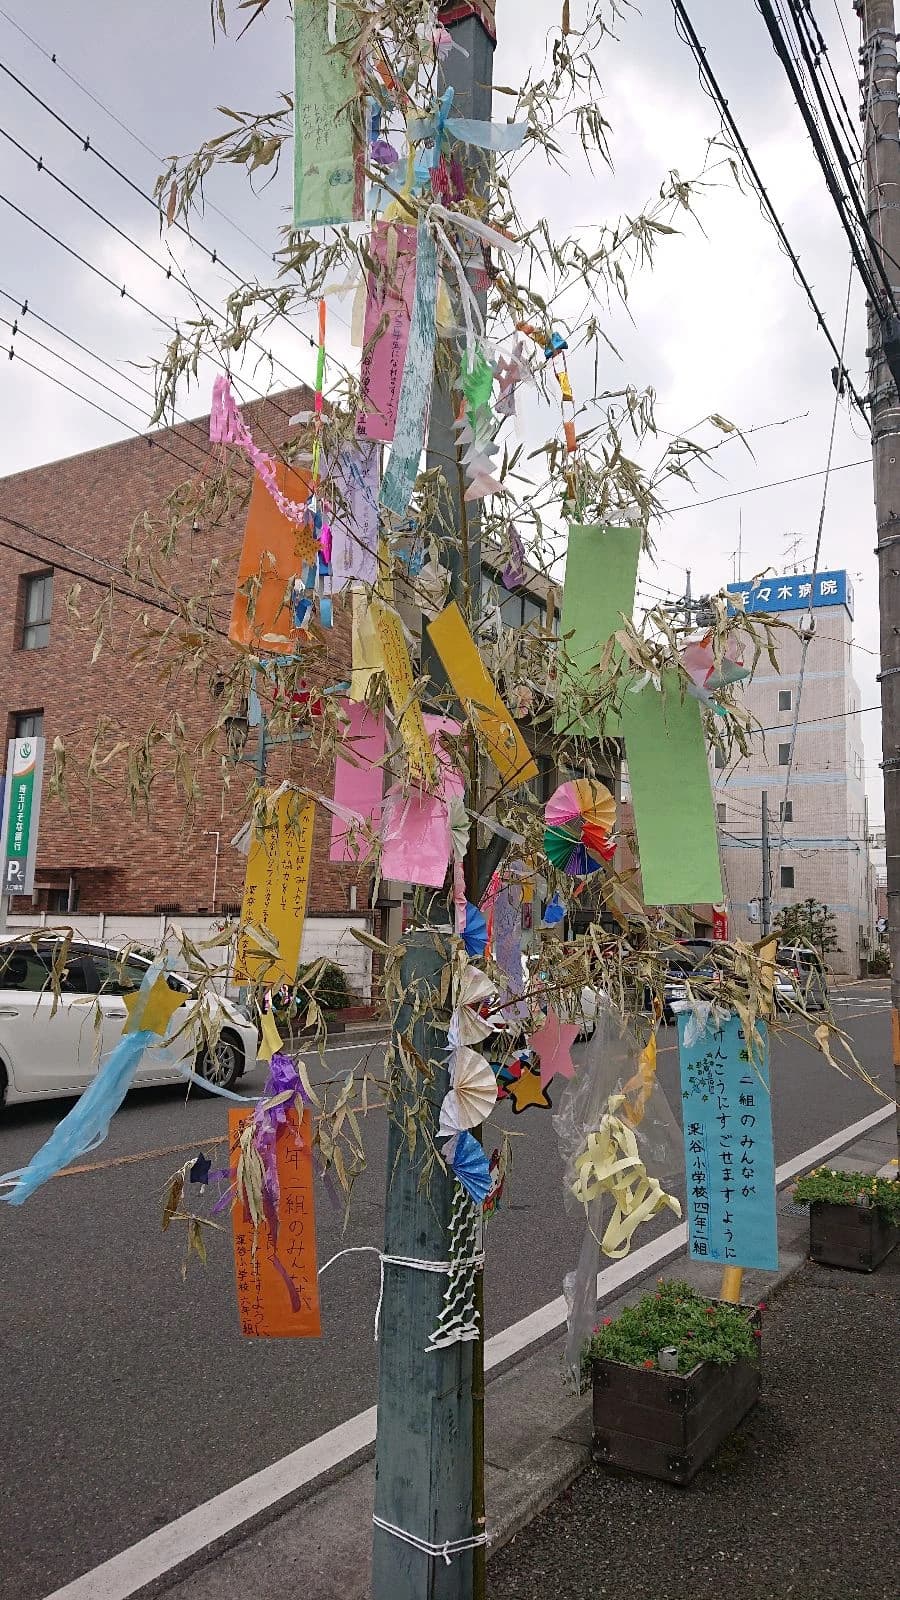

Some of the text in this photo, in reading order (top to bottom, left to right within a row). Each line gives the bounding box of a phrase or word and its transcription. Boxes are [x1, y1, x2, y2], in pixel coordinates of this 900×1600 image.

[8, 860, 20, 881] P
[686, 1122, 709, 1257] 深谷小学校四年二組
